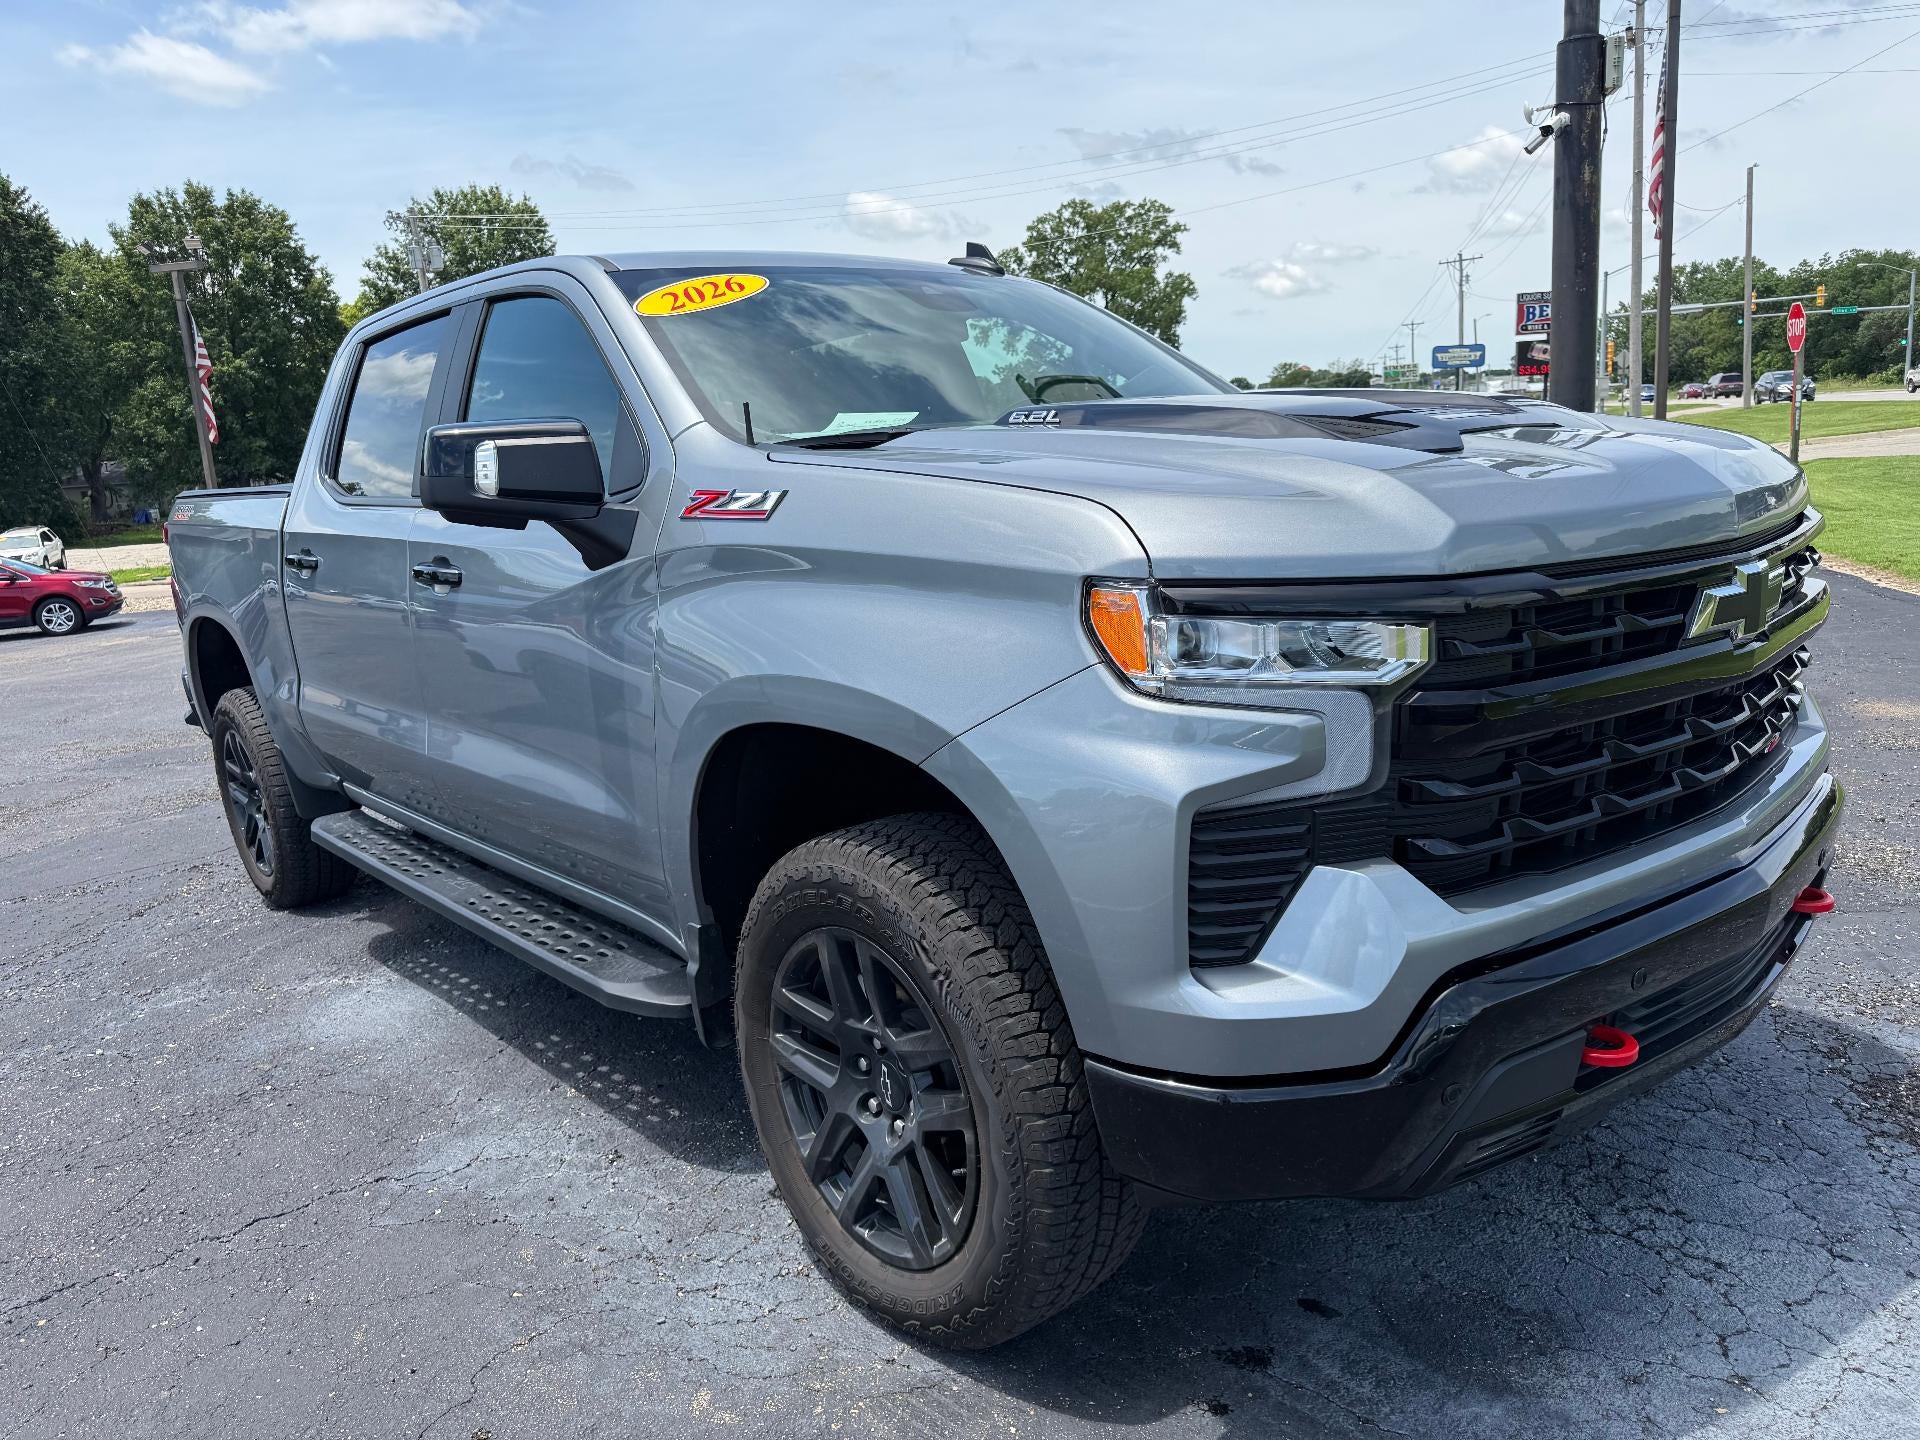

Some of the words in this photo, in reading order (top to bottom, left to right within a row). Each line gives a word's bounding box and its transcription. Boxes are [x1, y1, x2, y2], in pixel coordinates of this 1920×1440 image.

[661, 276, 746, 311] 2026
[1519, 293, 1542, 302] LIQUOR
[1788, 318, 1804, 336] STOP
[1008, 410, 1060, 423] 6.2L
[679, 489, 789, 521] Z71
[814, 1235, 966, 1316] BRIDGESTONE
